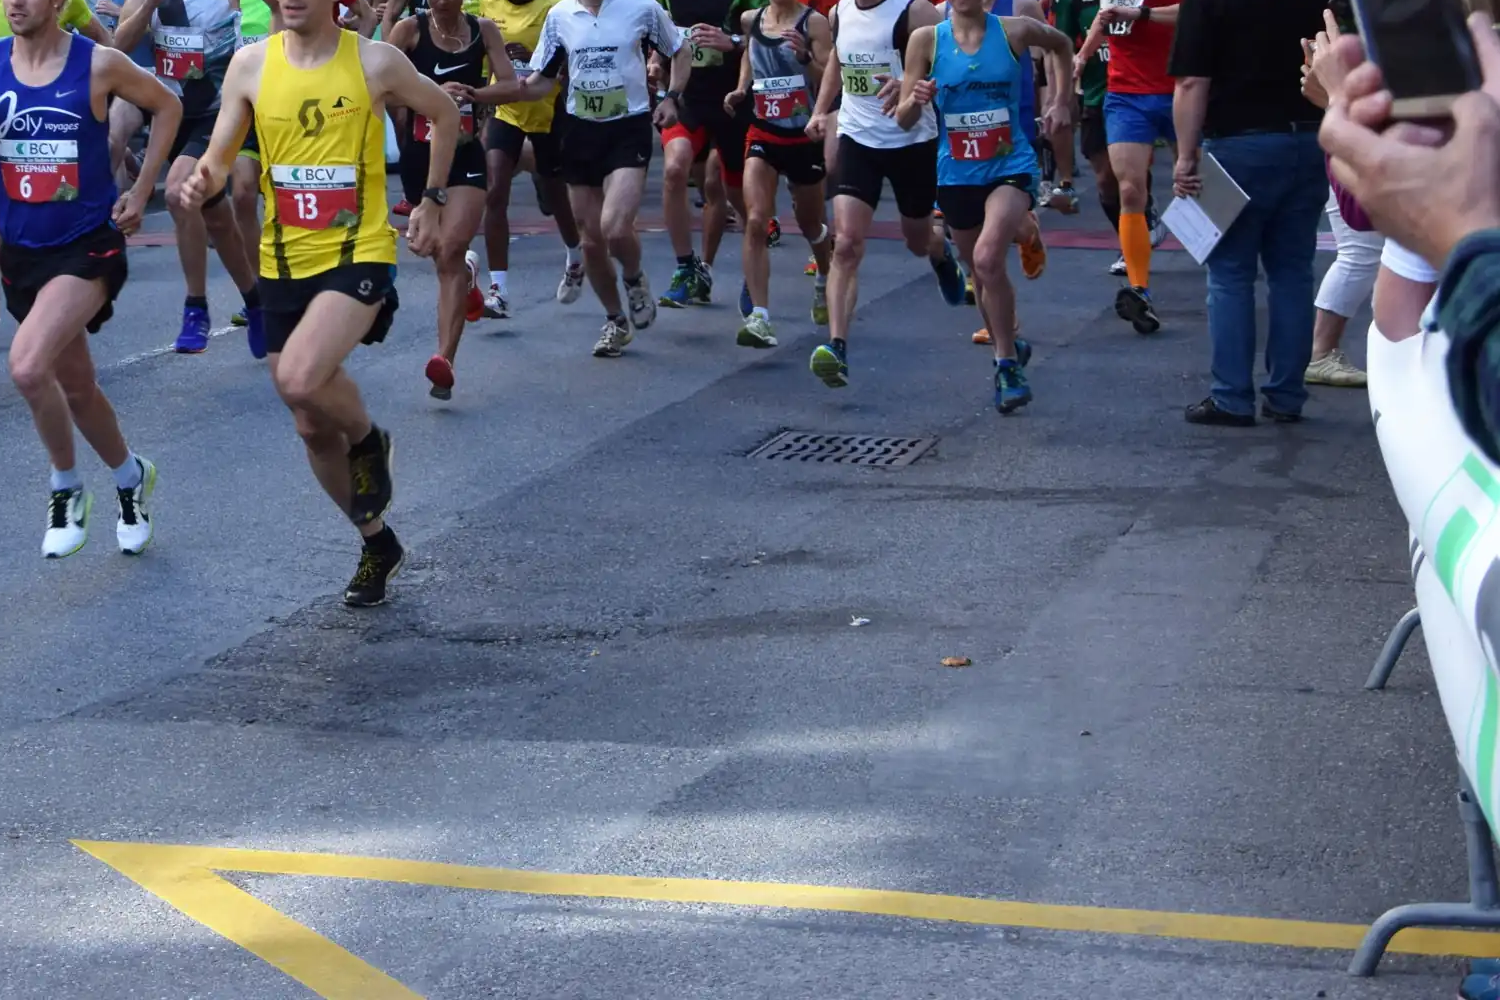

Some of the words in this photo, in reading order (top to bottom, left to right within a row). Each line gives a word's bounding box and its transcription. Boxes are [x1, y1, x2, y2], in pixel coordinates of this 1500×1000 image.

[169, 37, 190, 46] BCV
[243, 36, 258, 45] BCV
[855, 53, 875, 63] BCV
[161, 58, 174, 76] 12
[588, 79, 610, 89] BCV
[771, 78, 792, 88] BCV
[846, 75, 869, 93] 738
[763, 100, 781, 117] 26
[969, 112, 995, 124] BCV
[44, 121, 80, 133] voyages
[30, 142, 59, 155] BCV
[962, 139, 980, 159] 21
[306, 168, 336, 181] BCV
[19, 174, 32, 198] 6
[293, 192, 318, 220] 13
